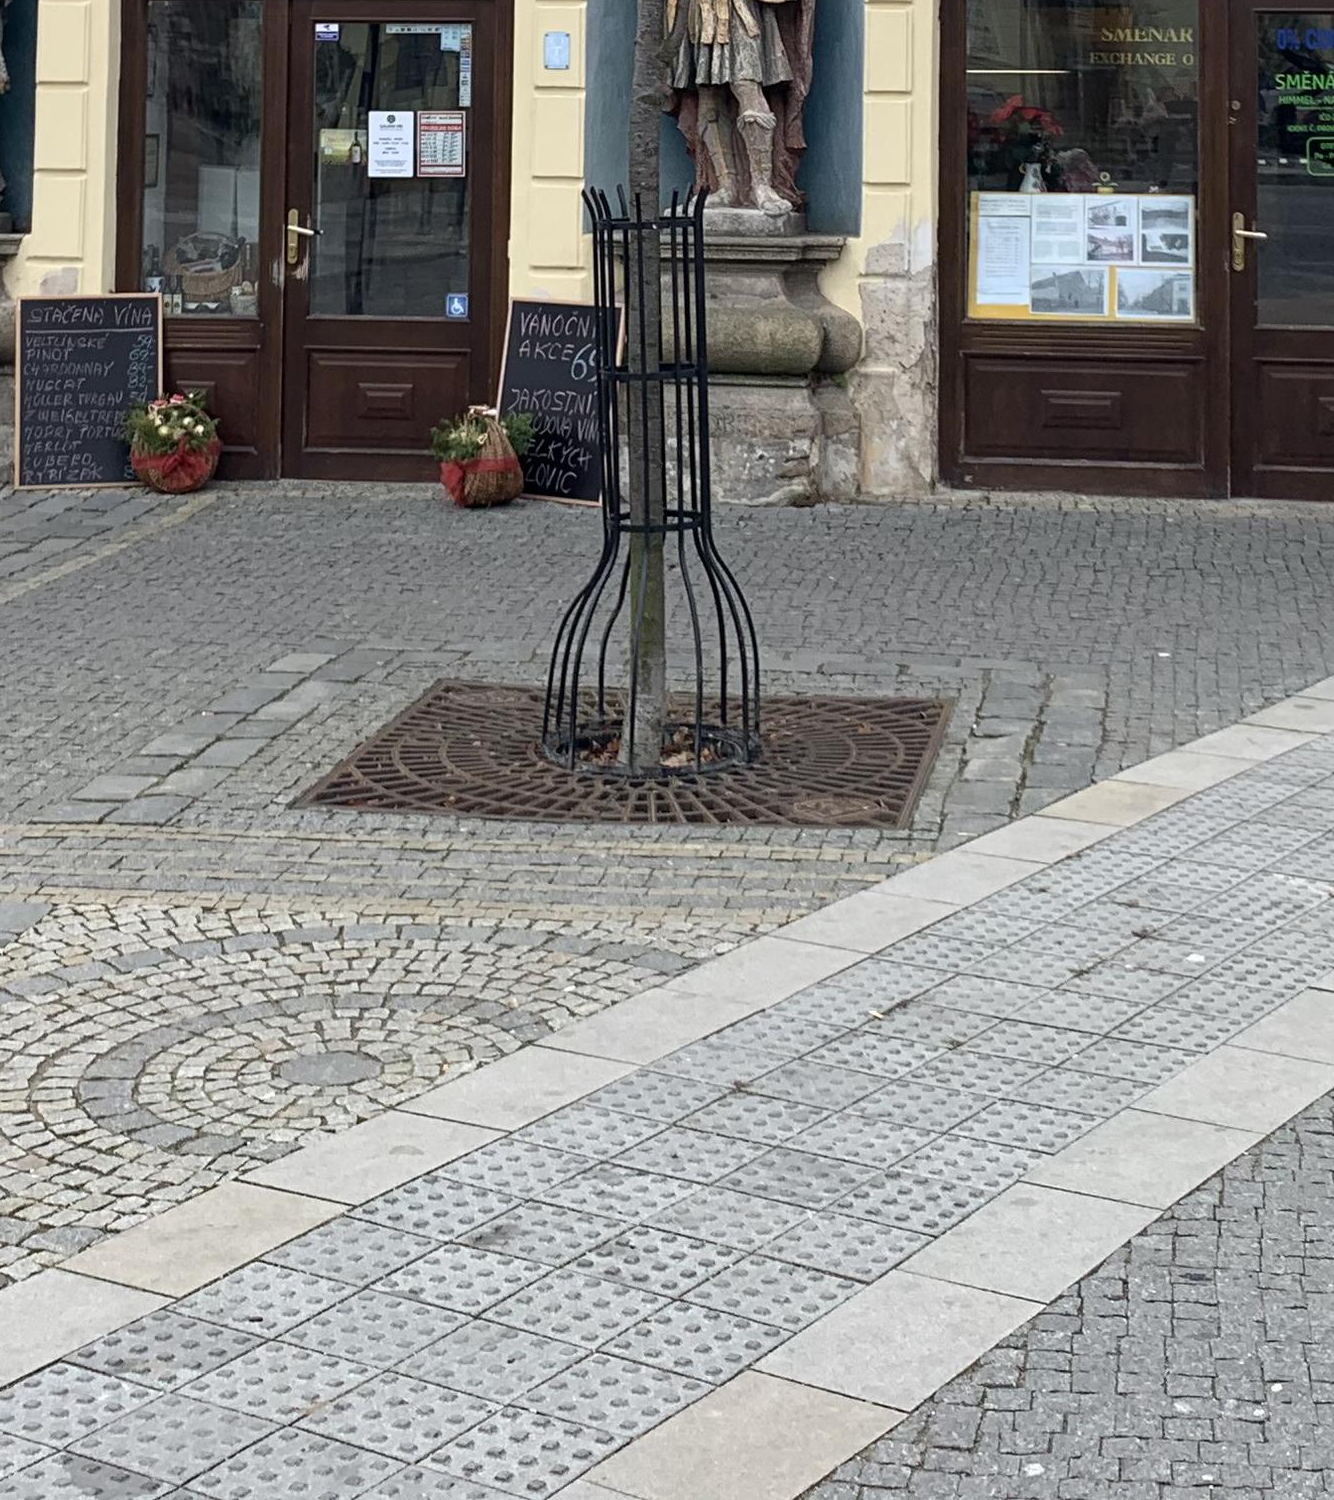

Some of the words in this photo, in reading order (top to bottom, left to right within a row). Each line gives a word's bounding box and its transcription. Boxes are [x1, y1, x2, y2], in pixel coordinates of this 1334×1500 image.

[1089, 51, 1177, 66] EXCHANGE
[114, 302, 152, 326] VÍNA
[25, 348, 73, 361] PINOT
[519, 340, 575, 361] AKCE
[23, 361, 115, 377] CHARDONNAY
